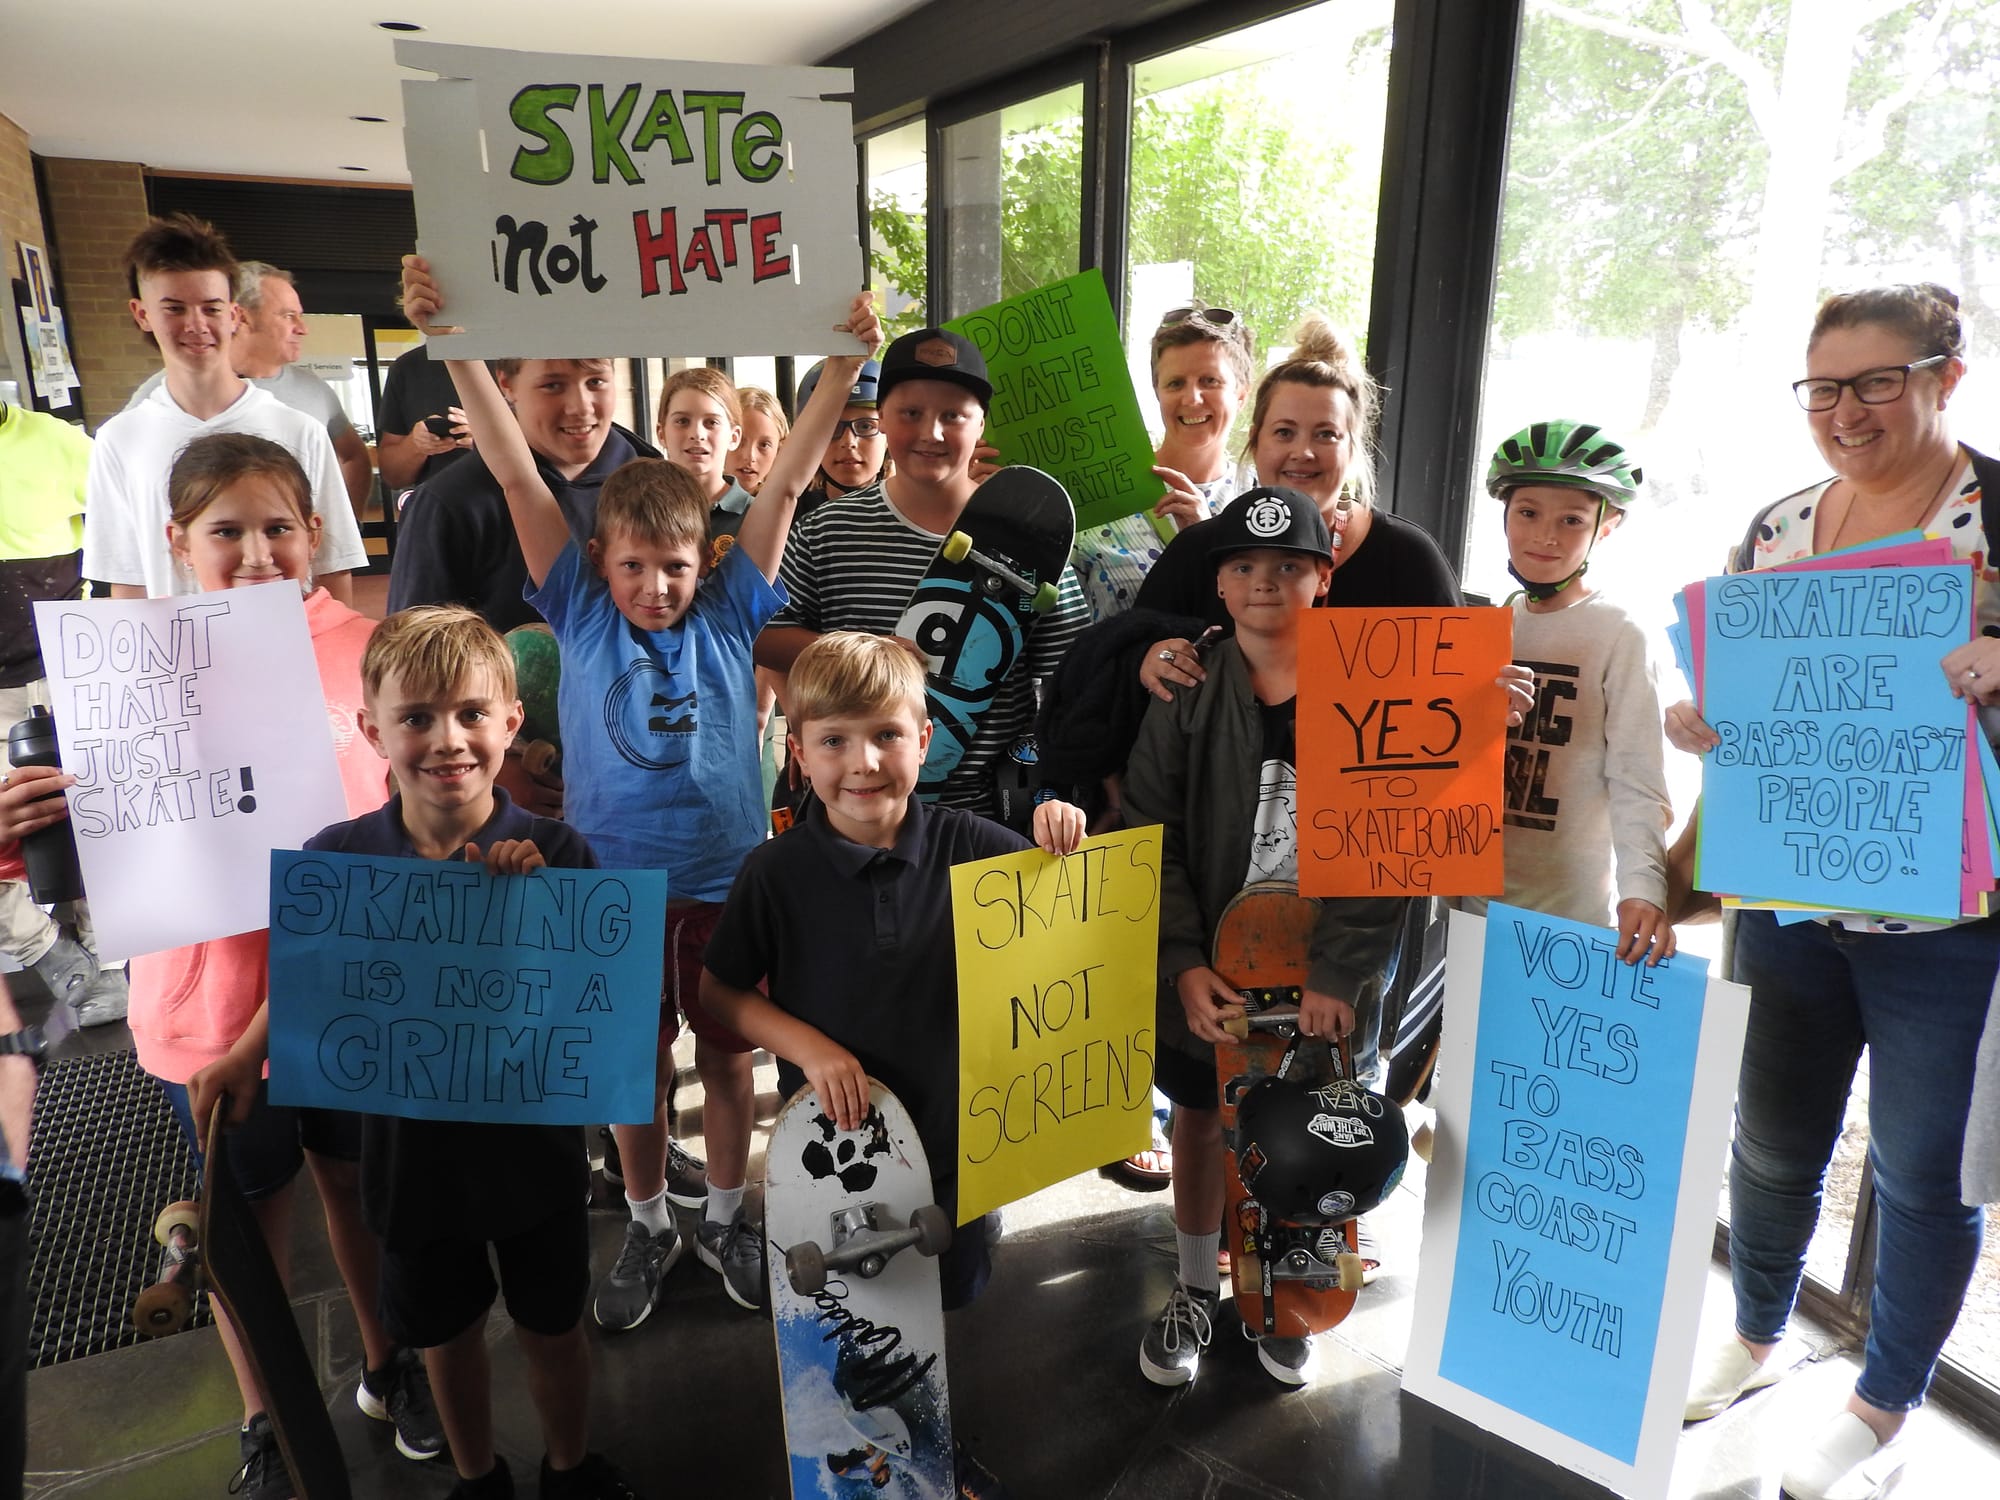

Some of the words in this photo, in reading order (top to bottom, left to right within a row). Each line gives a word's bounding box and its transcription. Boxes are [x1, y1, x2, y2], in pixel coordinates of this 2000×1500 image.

[495, 214, 608, 297] not
[632, 206, 791, 299] HATE
[961, 284, 1076, 364] DONT
[990, 346, 1100, 429] HATE
[1007, 404, 1117, 469] JUST
[1056, 453, 1135, 507] ATE
[1715, 573, 1963, 639] SKATERS
[1330, 616, 1469, 679] VOTE
[73, 673, 201, 730] HATE
[1773, 654, 1897, 712] ARE
[73, 721, 190, 787] JUST
[1333, 697, 1462, 764] YES
[1715, 720, 1821, 767] BASS
[1827, 723, 1965, 775] COAST
[1351, 775, 1418, 798] TO
[1758, 775, 1929, 833] PEOPLE
[1312, 803, 1501, 860] SKATEBOARD-
[974, 839, 1156, 950] SKATES
[1370, 858, 1432, 892] ING
[277, 860, 632, 957] SKATING
[343, 960, 405, 1005] IS
[435, 965, 551, 1016] NOT
[576, 974, 612, 1012] A
[1513, 921, 1670, 1009] VOTE
[1010, 964, 1105, 1050] NOT
[317, 1014, 592, 1102] CRIME
[1532, 998, 1639, 1084] YES
[967, 1029, 1154, 1163] SCREENS
[1492, 1061, 1560, 1117] TO
[1333, 1132, 1356, 1144] VANS
[1337, 1120, 1351, 1133] THE
[1503, 1119, 1645, 1200] BASS
[1476, 1171, 1637, 1264] COAST
[1492, 1239, 1623, 1358] YOUTH
